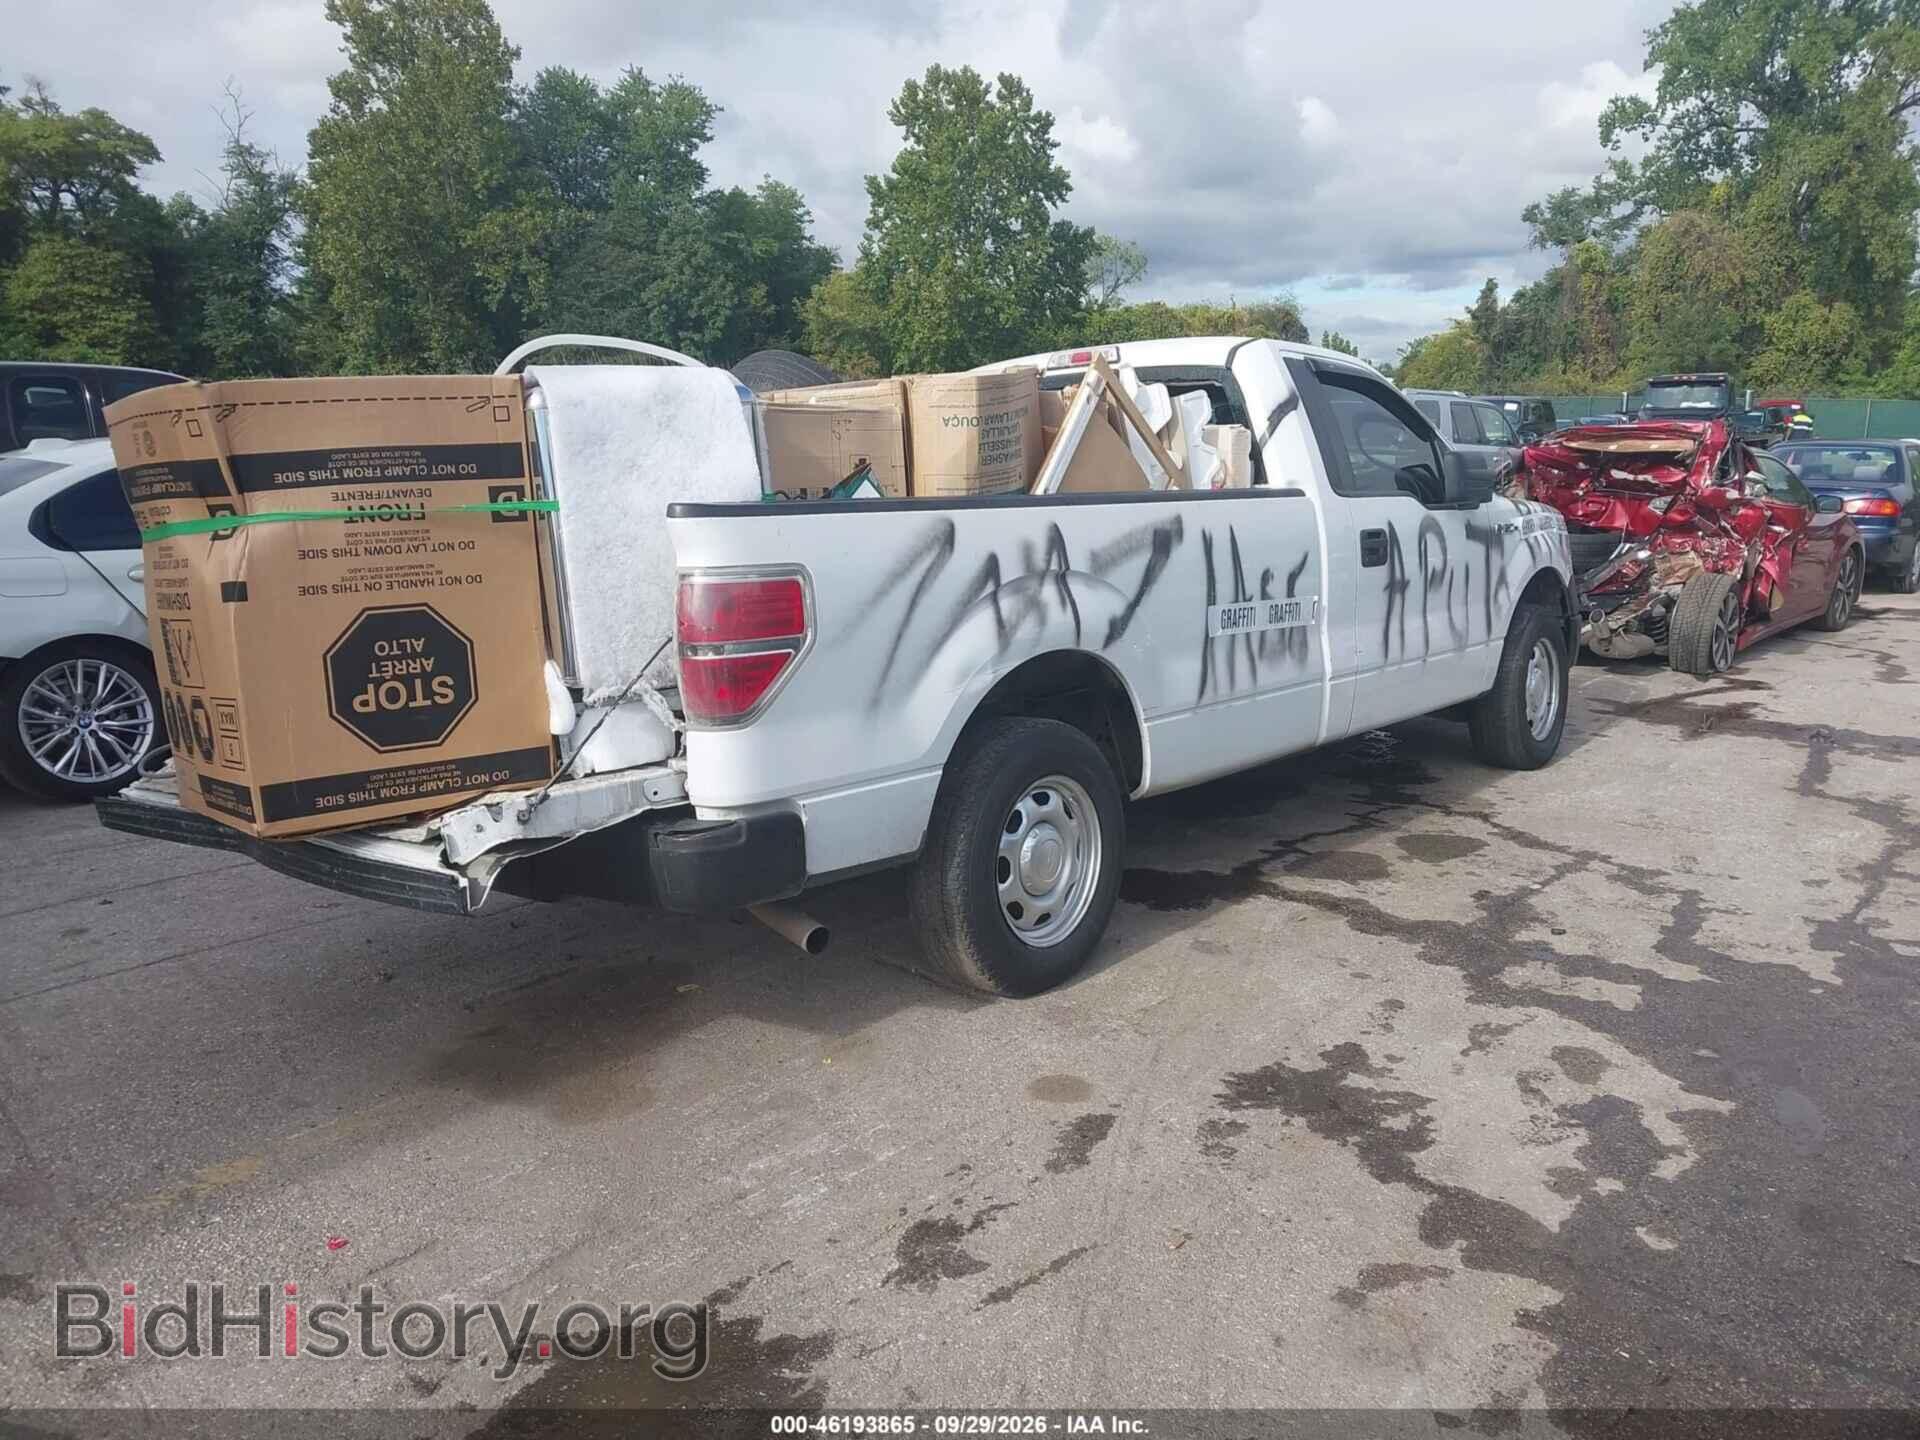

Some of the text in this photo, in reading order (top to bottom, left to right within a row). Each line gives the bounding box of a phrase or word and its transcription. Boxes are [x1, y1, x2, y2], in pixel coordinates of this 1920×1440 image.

[942, 414, 983, 428] LOUÇA
[272, 464, 476, 484] DO NOT CLAMP FROM THIS SIDE
[330, 488, 432, 502] DEVANT/FRENTE
[344, 502, 426, 524] FRONT
[298, 541, 475, 560] DO NOT LAY DOWN THIS SIDE
[298, 574, 481, 596] DO NOT HANDLE ON THIS SIDE
[1221, 606, 1256, 630] GRAFFITI
[1268, 602, 1301, 625] GRAFFITI
[374, 637, 424, 656] ALTO
[368, 657, 435, 680] ARRÊT
[352, 675, 455, 713] STOP
[314, 770, 509, 808] DO NOT CLAMP FROM THIS SIDE
